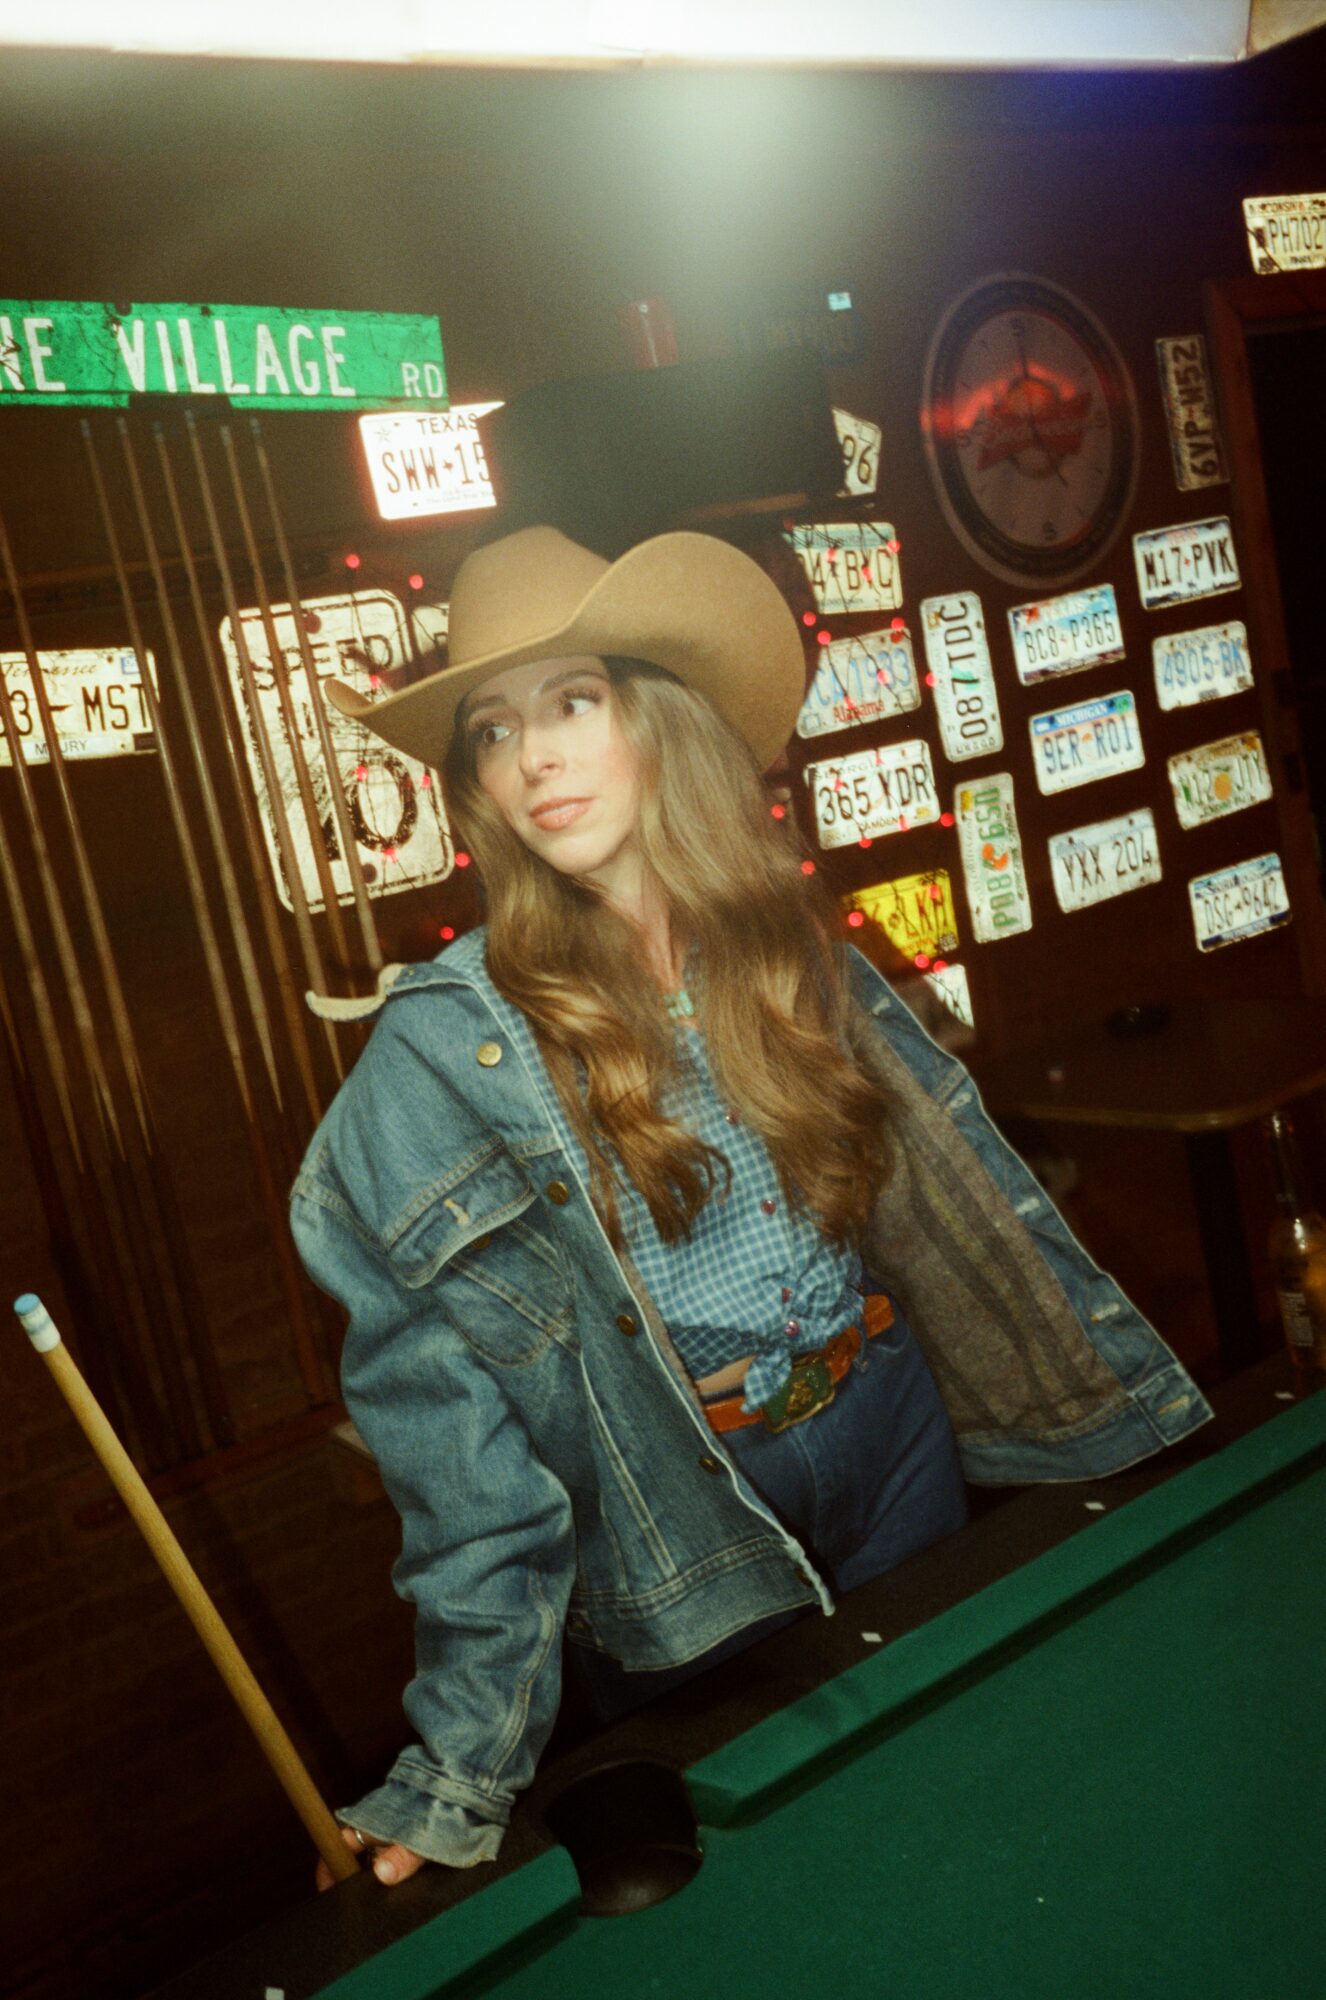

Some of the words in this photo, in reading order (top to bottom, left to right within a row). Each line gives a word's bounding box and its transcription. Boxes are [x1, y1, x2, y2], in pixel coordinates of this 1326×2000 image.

[112, 317, 356, 397] VILLAGE
[401, 361, 444, 399] RD
[416, 412, 479, 436] TEXAS
[381, 446, 441, 494] SWW
[1191, 537, 1235, 580] PVK
[1069, 609, 1117, 653] P365
[34, 740, 88, 757] MURY
[818, 776, 872, 826] 365
[1111, 831, 1153, 878] 204
